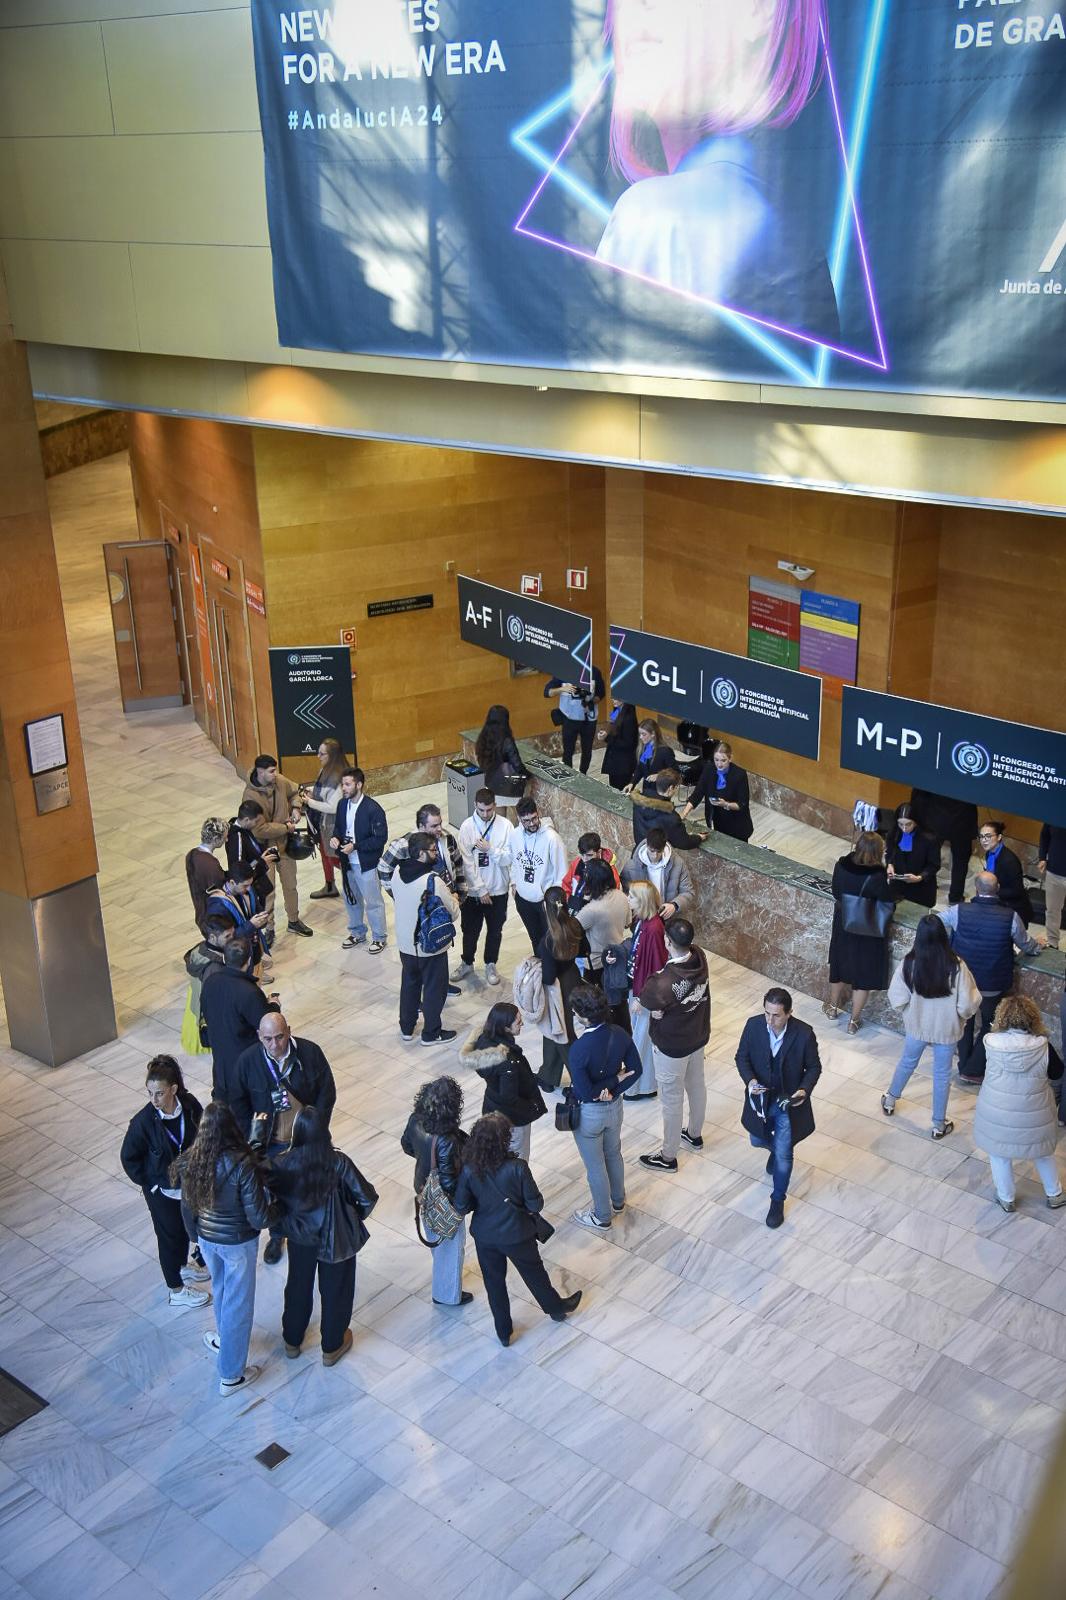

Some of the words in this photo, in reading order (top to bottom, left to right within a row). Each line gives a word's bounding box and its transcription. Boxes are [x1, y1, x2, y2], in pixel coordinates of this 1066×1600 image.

[955, 21, 994, 49] DE
[1003, 13, 1066, 45] GRA
[283, 52, 336, 85] FOR
[445, 40, 506, 75] ERA
[287, 104, 443, 130] #AndalucIA24
[1000, 279, 1040, 294] Junta
[1043, 279, 1062, 294] de
[465, 600, 493, 629] A-F
[642, 659, 687, 695] G-L
[740, 695, 778, 711] INTELIGENCIA
[778, 706, 809, 720] ARTIFICIAL
[745, 689, 776, 703] CONGRESO
[776, 698, 784, 706] DE
[748, 704, 780, 719] ANDALUCÍA
[856, 717, 923, 757] M-P
[992, 762, 1046, 780] INTELIGENCIA
[1000, 756, 1043, 772] CONGRESO
[1044, 766, 1056, 775] DE
[992, 770, 1003, 778] DE
[1004, 772, 1049, 790] ANDALUCÍA
